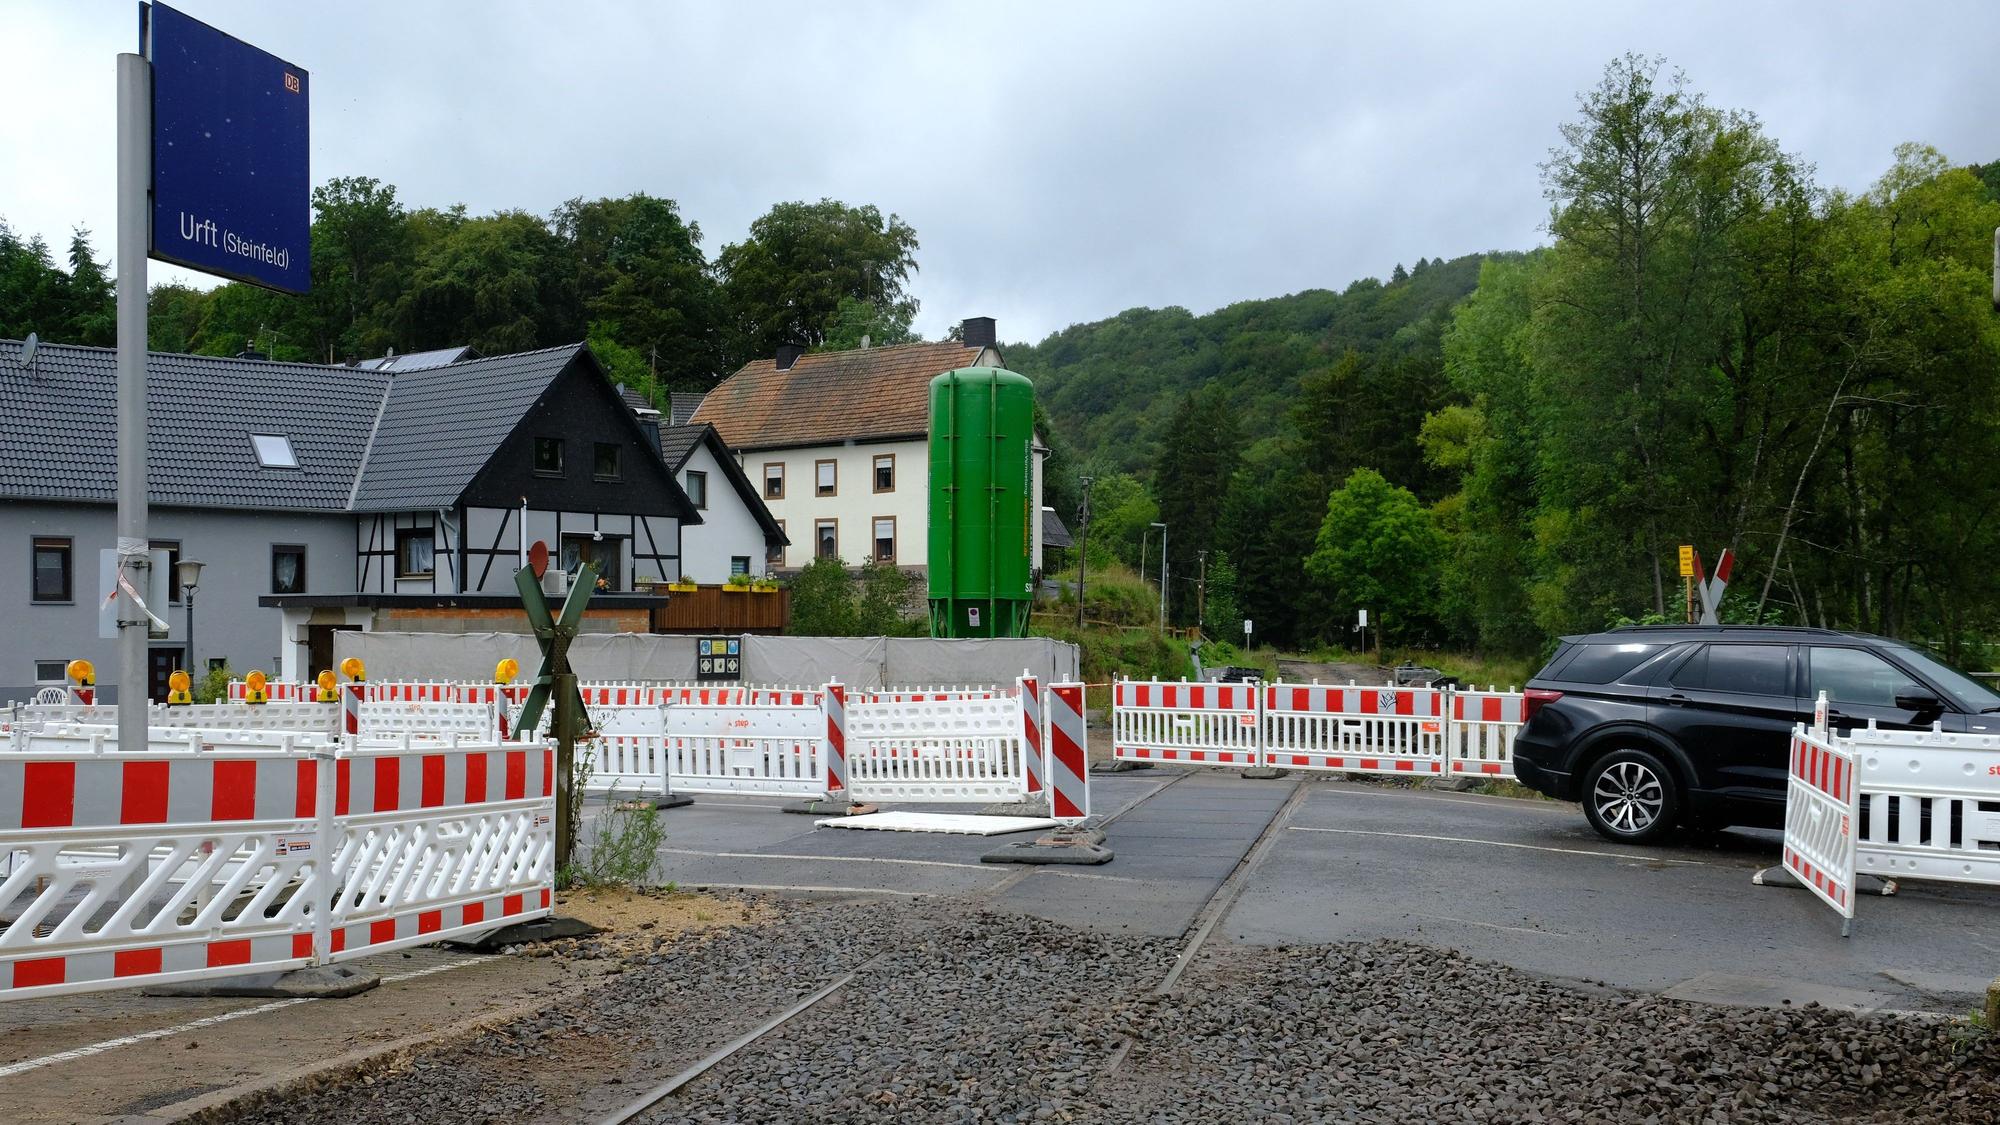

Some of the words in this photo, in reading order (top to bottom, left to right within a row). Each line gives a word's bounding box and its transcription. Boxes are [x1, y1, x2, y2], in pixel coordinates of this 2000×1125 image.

[286, 74, 298, 91] DB
[180, 211, 218, 248] Urft
[223, 229, 289, 270] (Steinfeld)
